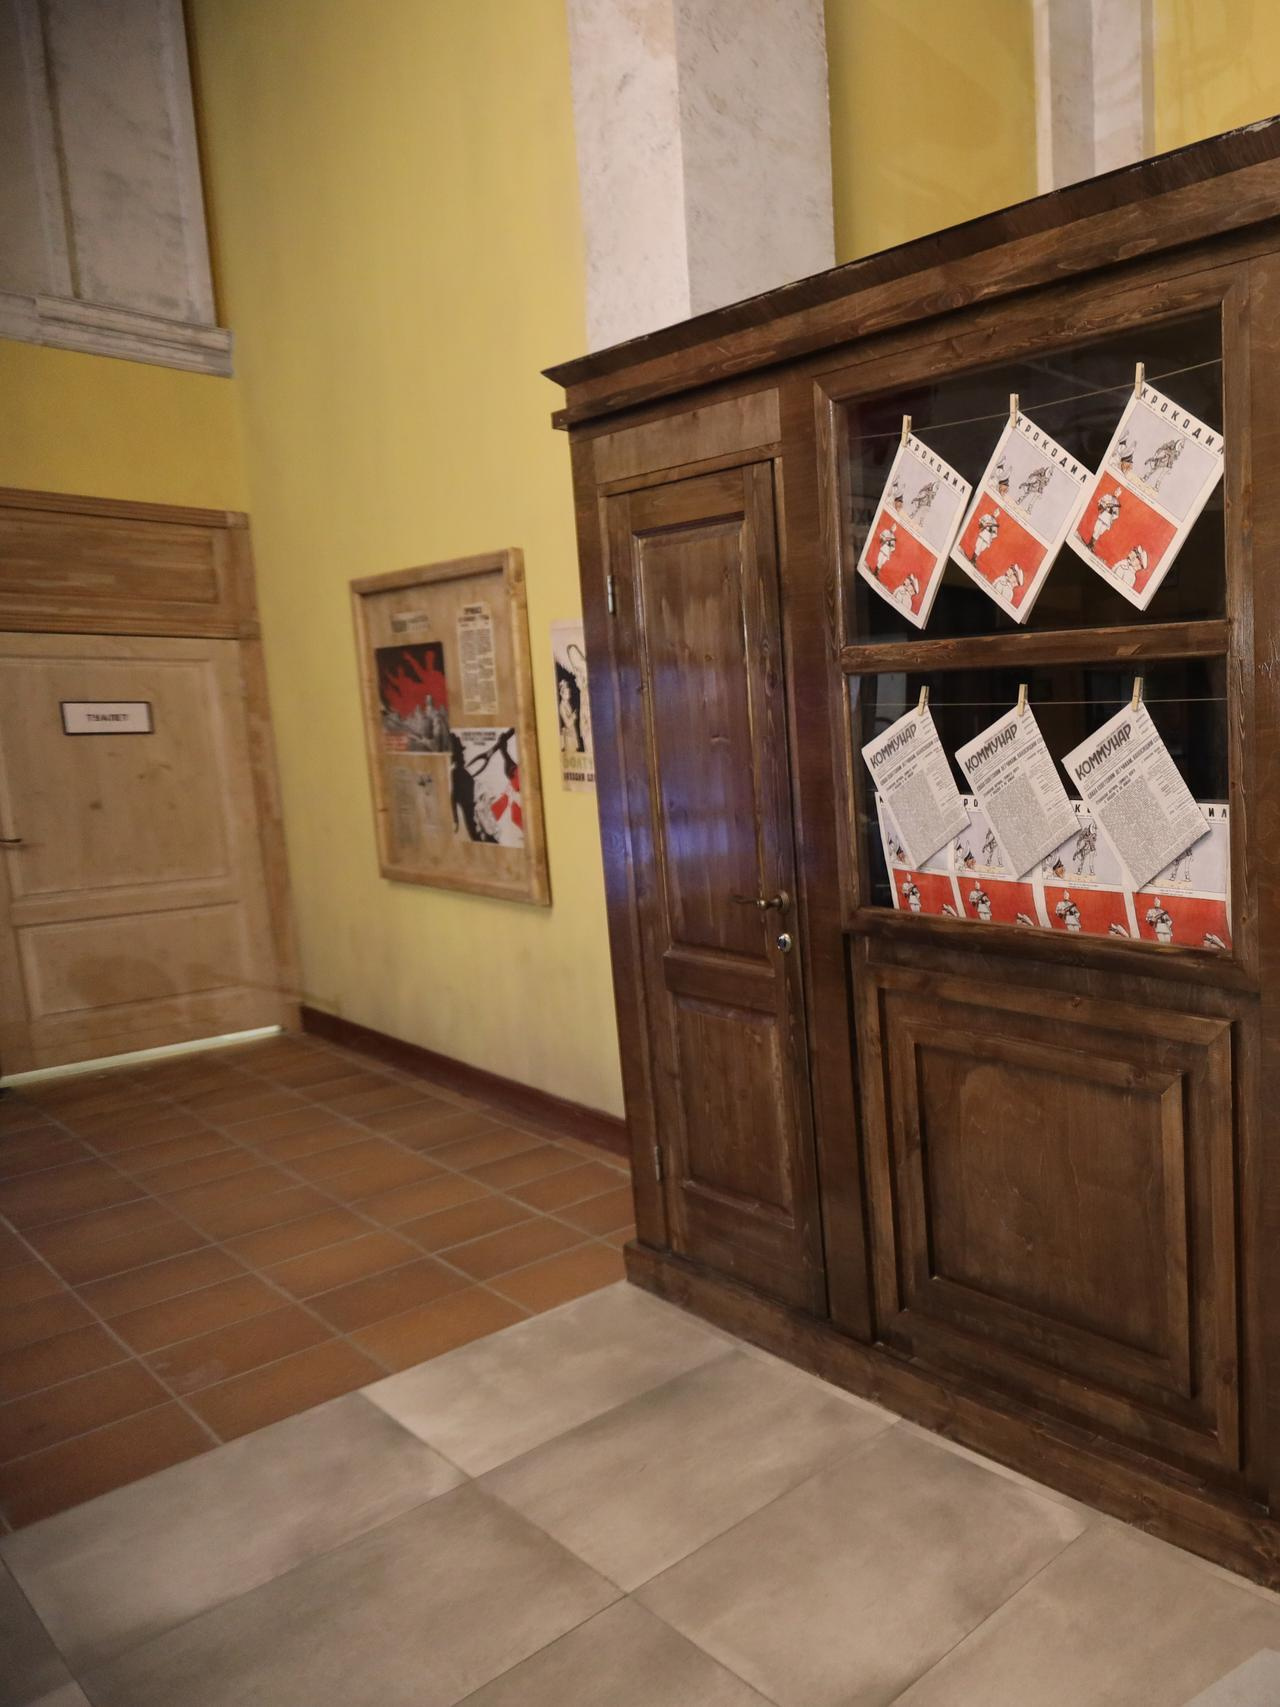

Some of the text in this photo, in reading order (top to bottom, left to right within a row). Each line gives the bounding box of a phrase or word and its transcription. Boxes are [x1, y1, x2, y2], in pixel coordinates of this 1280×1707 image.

[1016, 415, 1087, 483] КРОКОДИЛ
[1141, 387, 1224, 455] КРОКОДИЛ
[906, 438, 966, 494] КРОКОДИЛ
[85, 713, 129, 722] ТУАЛЕТ
[870, 723, 917, 769] КОММУНАР
[964, 723, 1018, 774] КОММУНАР
[1074, 723, 1132, 781] КОММУНАР
